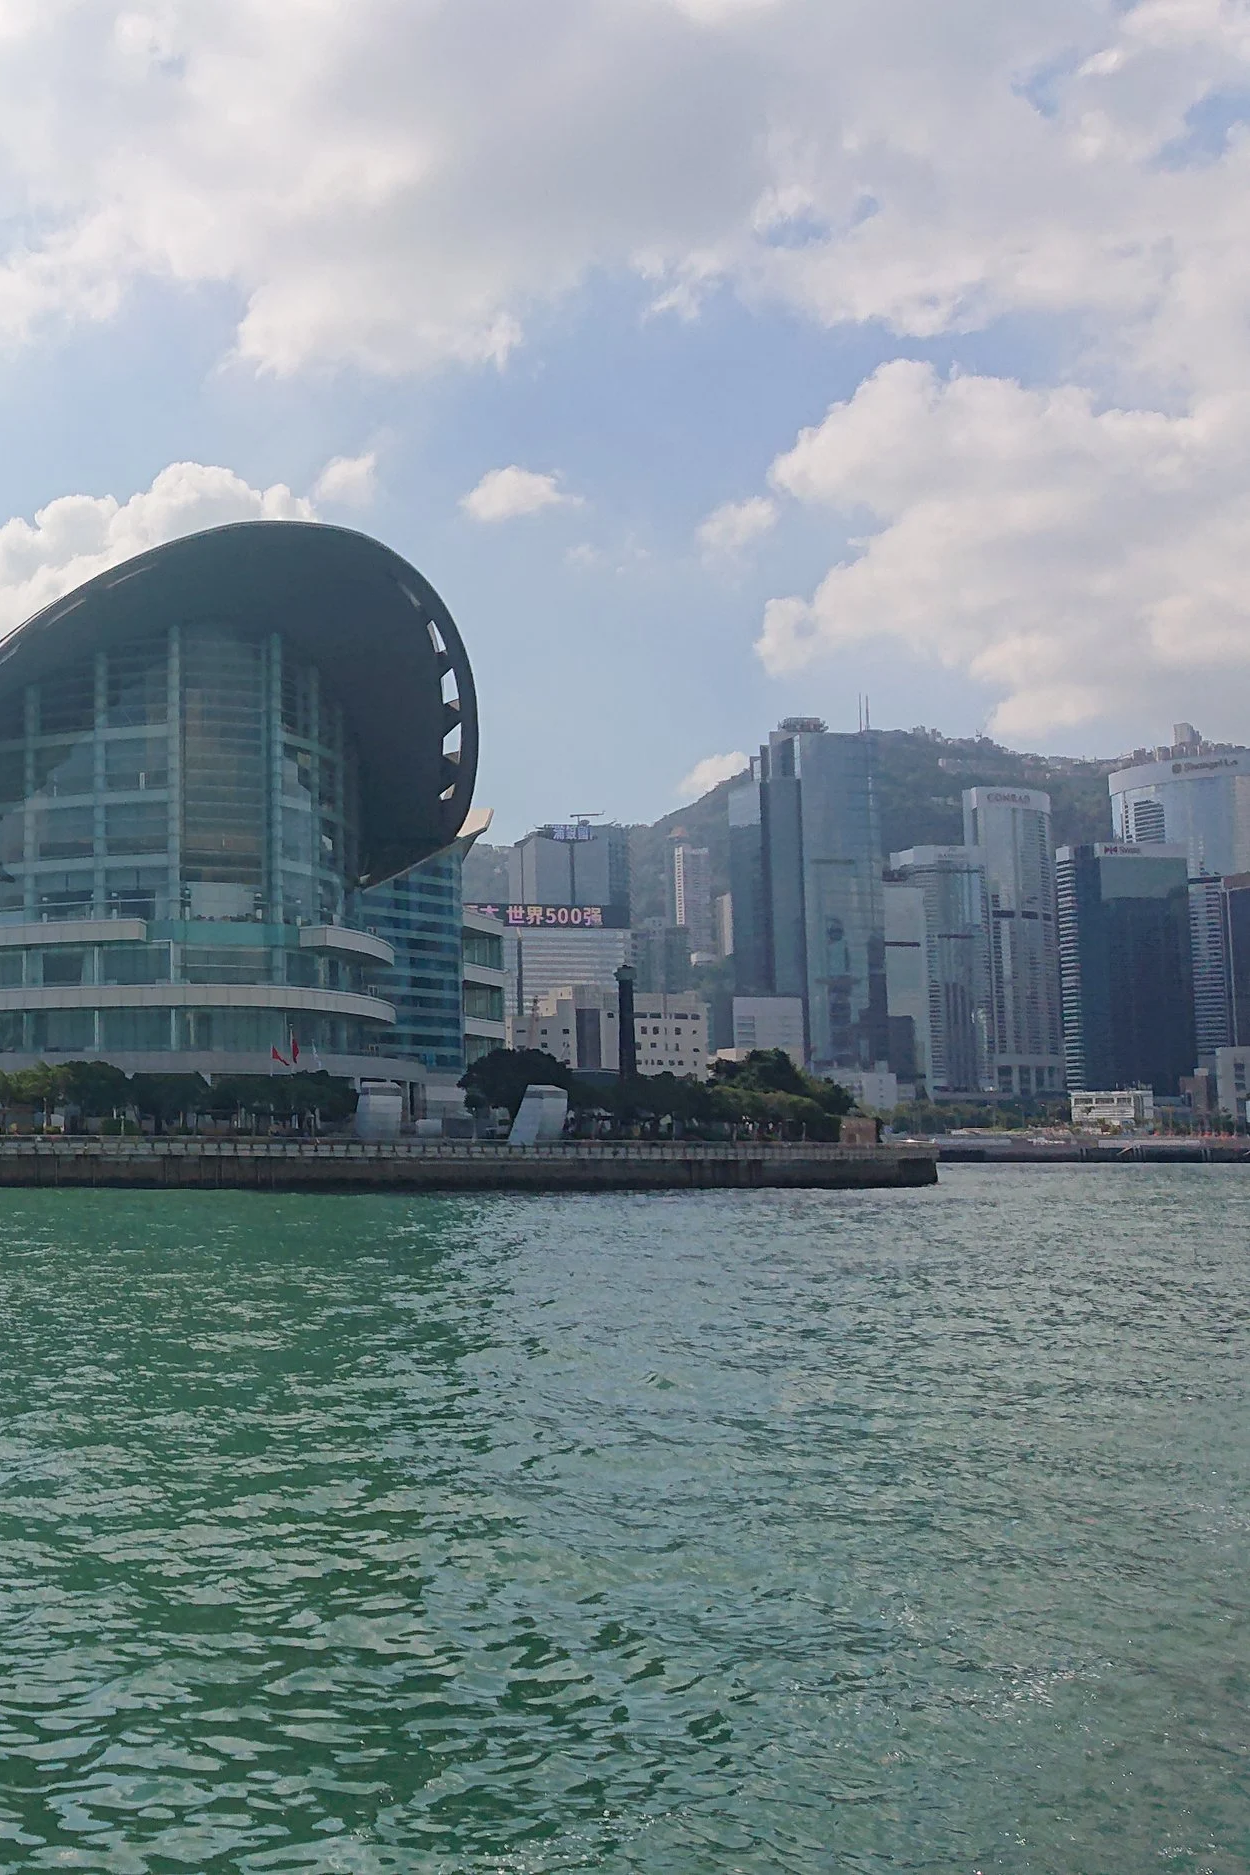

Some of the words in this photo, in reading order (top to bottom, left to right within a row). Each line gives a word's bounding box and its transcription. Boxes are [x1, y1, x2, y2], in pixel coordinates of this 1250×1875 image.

[987, 792, 1031, 802] CONRAD
[506, 905, 603, 926] 世界500强
